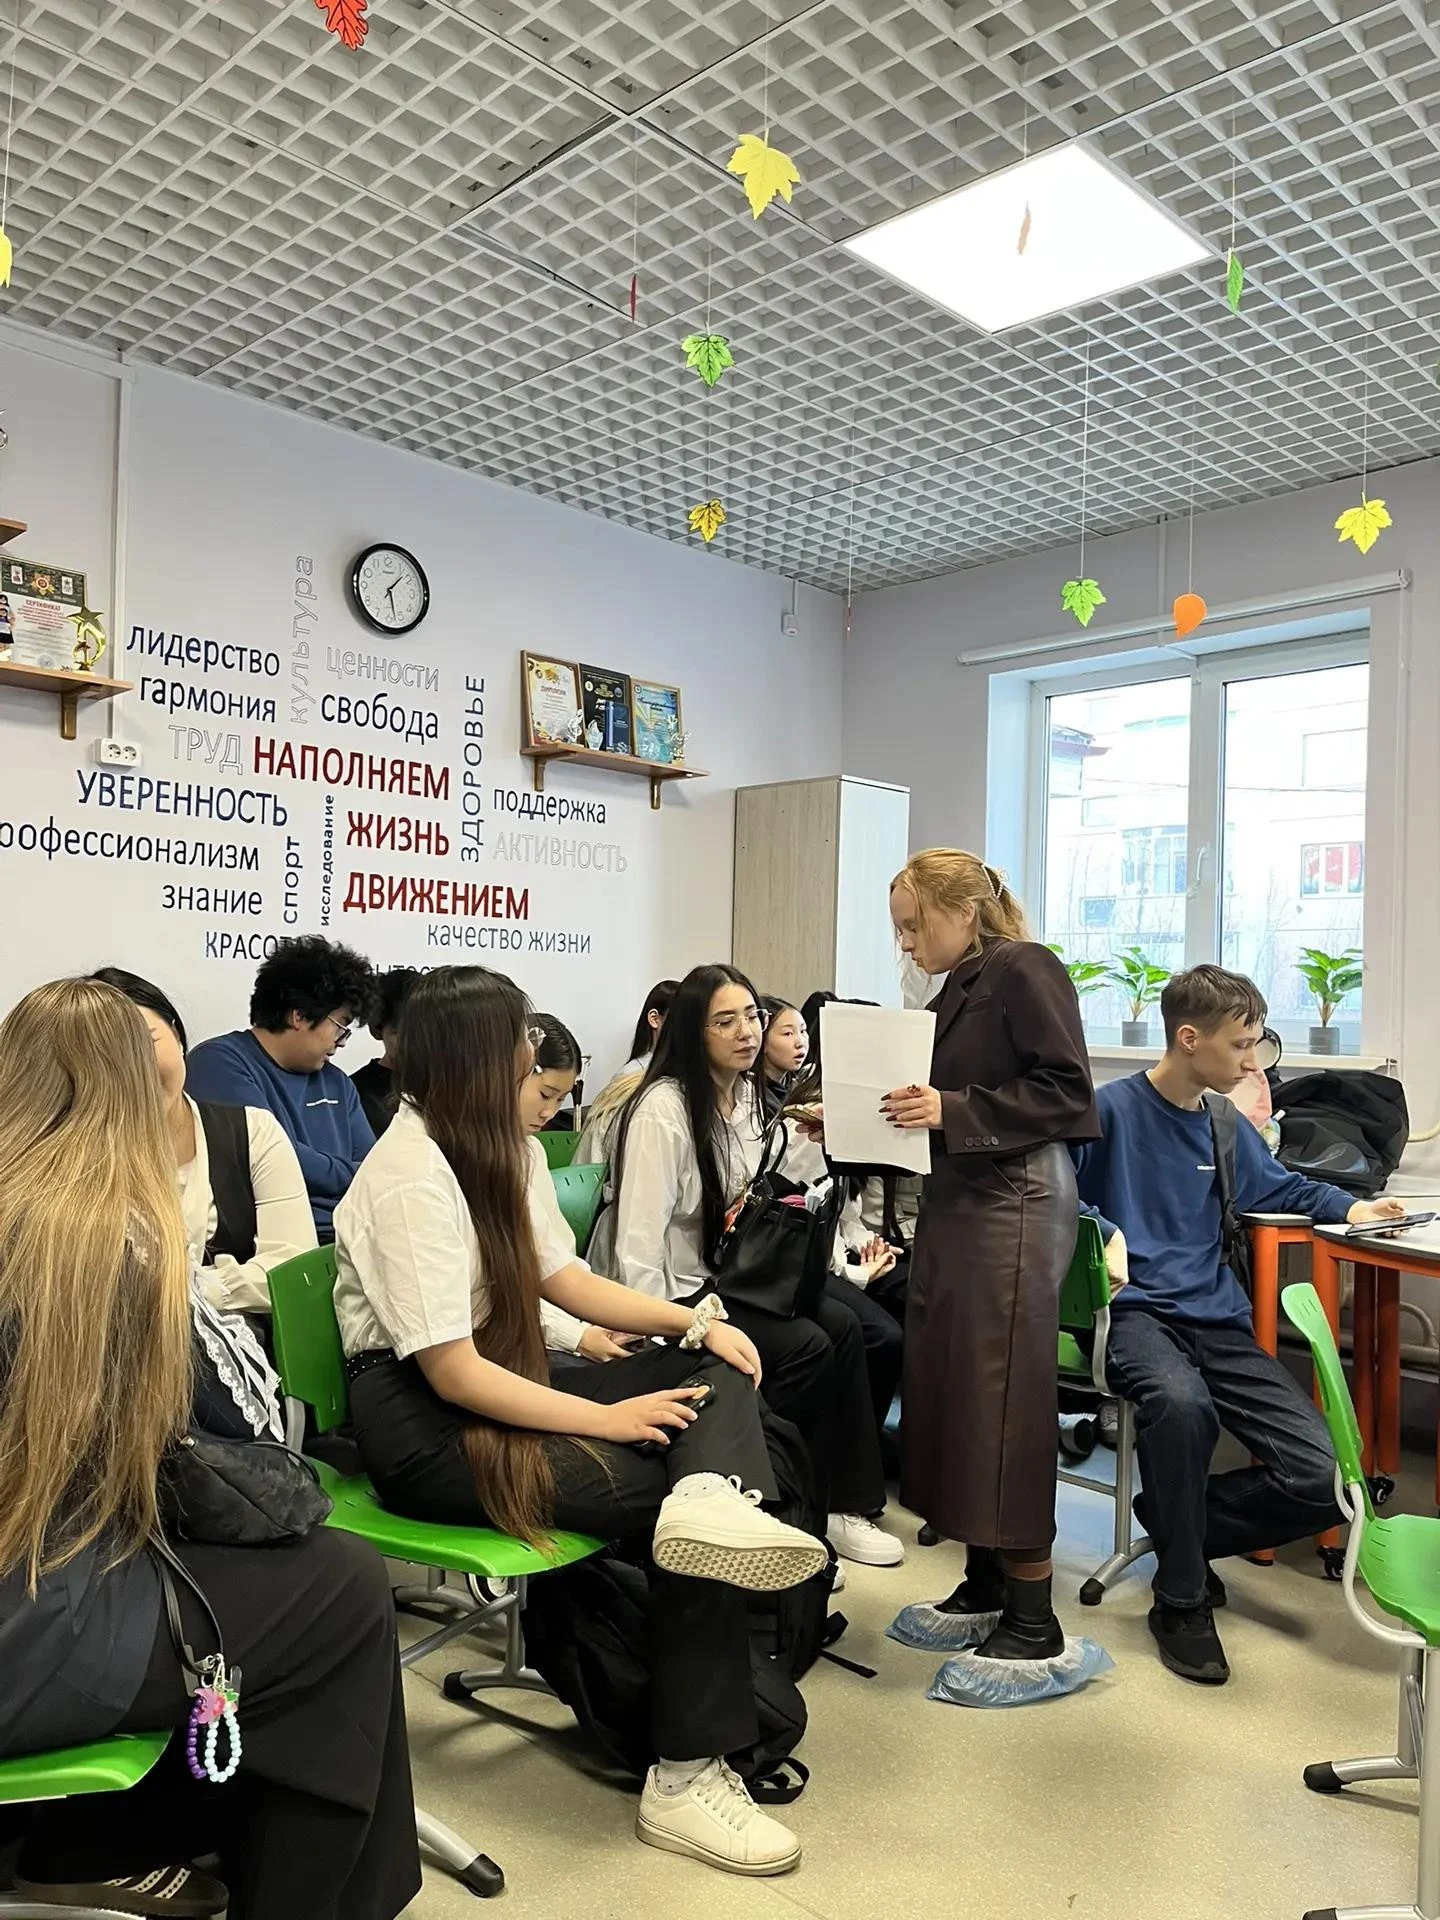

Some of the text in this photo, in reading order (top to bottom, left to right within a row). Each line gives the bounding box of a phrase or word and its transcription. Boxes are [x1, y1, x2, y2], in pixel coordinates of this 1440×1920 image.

[126, 626, 280, 677] лидерство
[290, 555, 319, 724] культура
[326, 646, 440, 692] ценности
[140, 676, 276, 723] гармония
[321, 692, 439, 745] свобода
[168, 724, 243, 776] ТРУД
[254, 736, 450, 801] НАПОЛНЯЕМ
[460, 675, 485, 863] ЗДОРОВЬЕ
[76, 769, 288, 827] УВЕРЕННОСТЬ
[493, 788, 606, 825] поддержка
[346, 810, 450, 856] ЖИЗНЬ
[492, 831, 628, 873] АКТИВНОСТЬ
[283, 835, 303, 924] спорт
[320, 794, 335, 927] исследование
[162, 884, 263, 915] знание
[343, 871, 529, 921] ДВИЖЕНИЕМ
[205, 930, 292, 960] КРАСО
[427, 923, 591, 954] качество жизни
